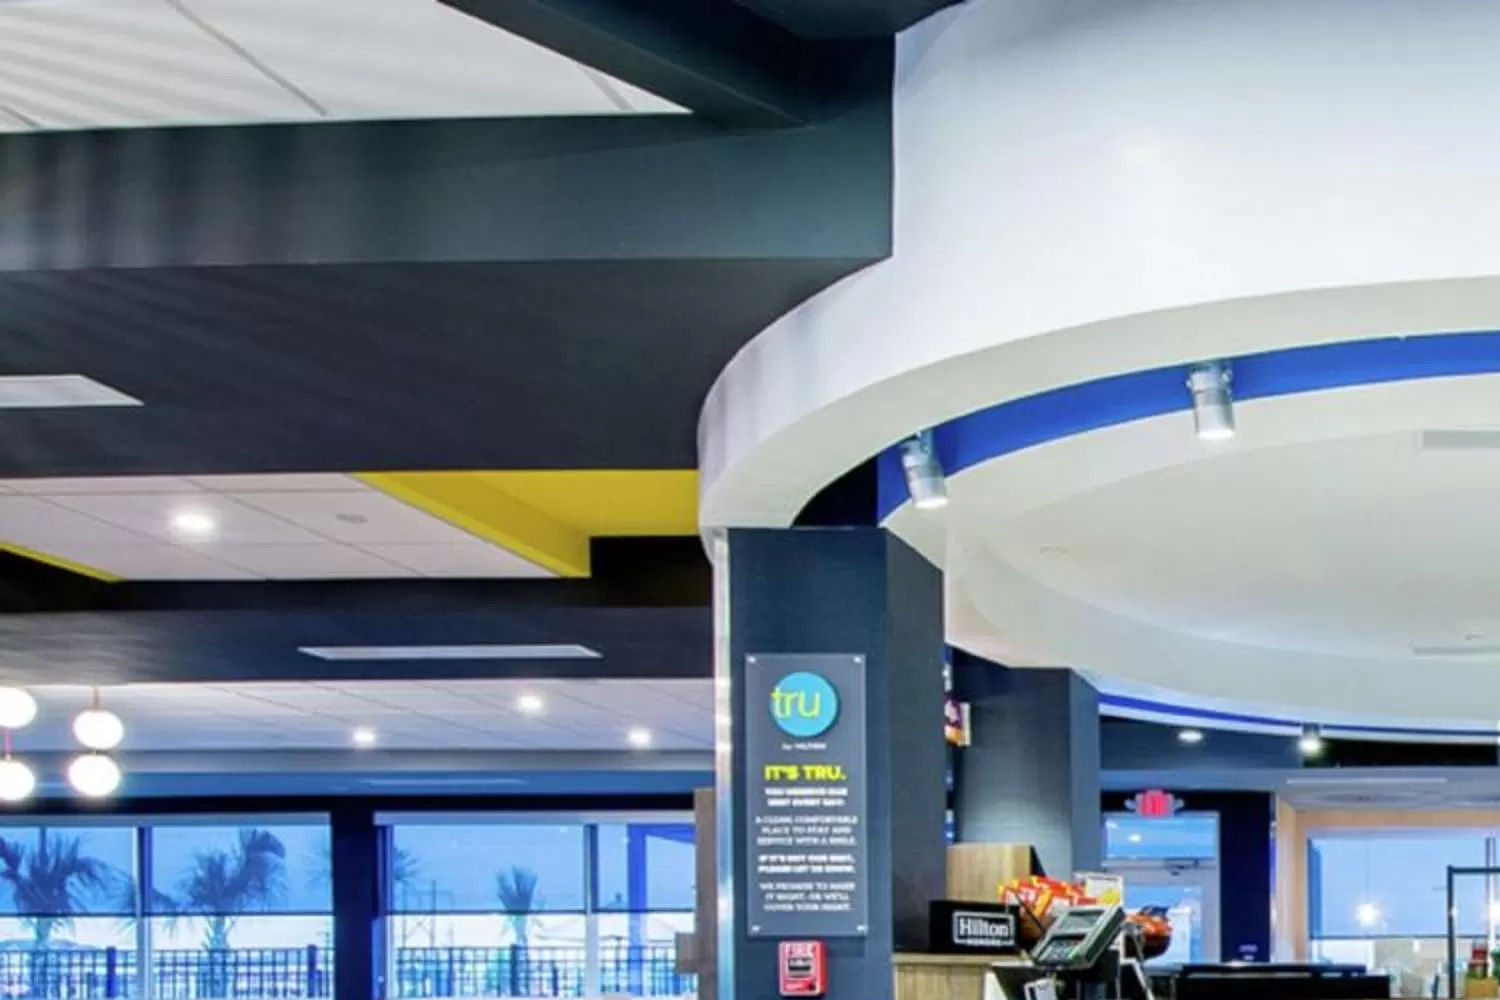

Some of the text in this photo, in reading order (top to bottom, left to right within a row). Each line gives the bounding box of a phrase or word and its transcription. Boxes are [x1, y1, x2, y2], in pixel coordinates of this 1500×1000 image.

[770, 687, 820, 719] tru
[764, 764, 848, 781] IT'S TRU.
[959, 917, 1009, 937] Hilton
